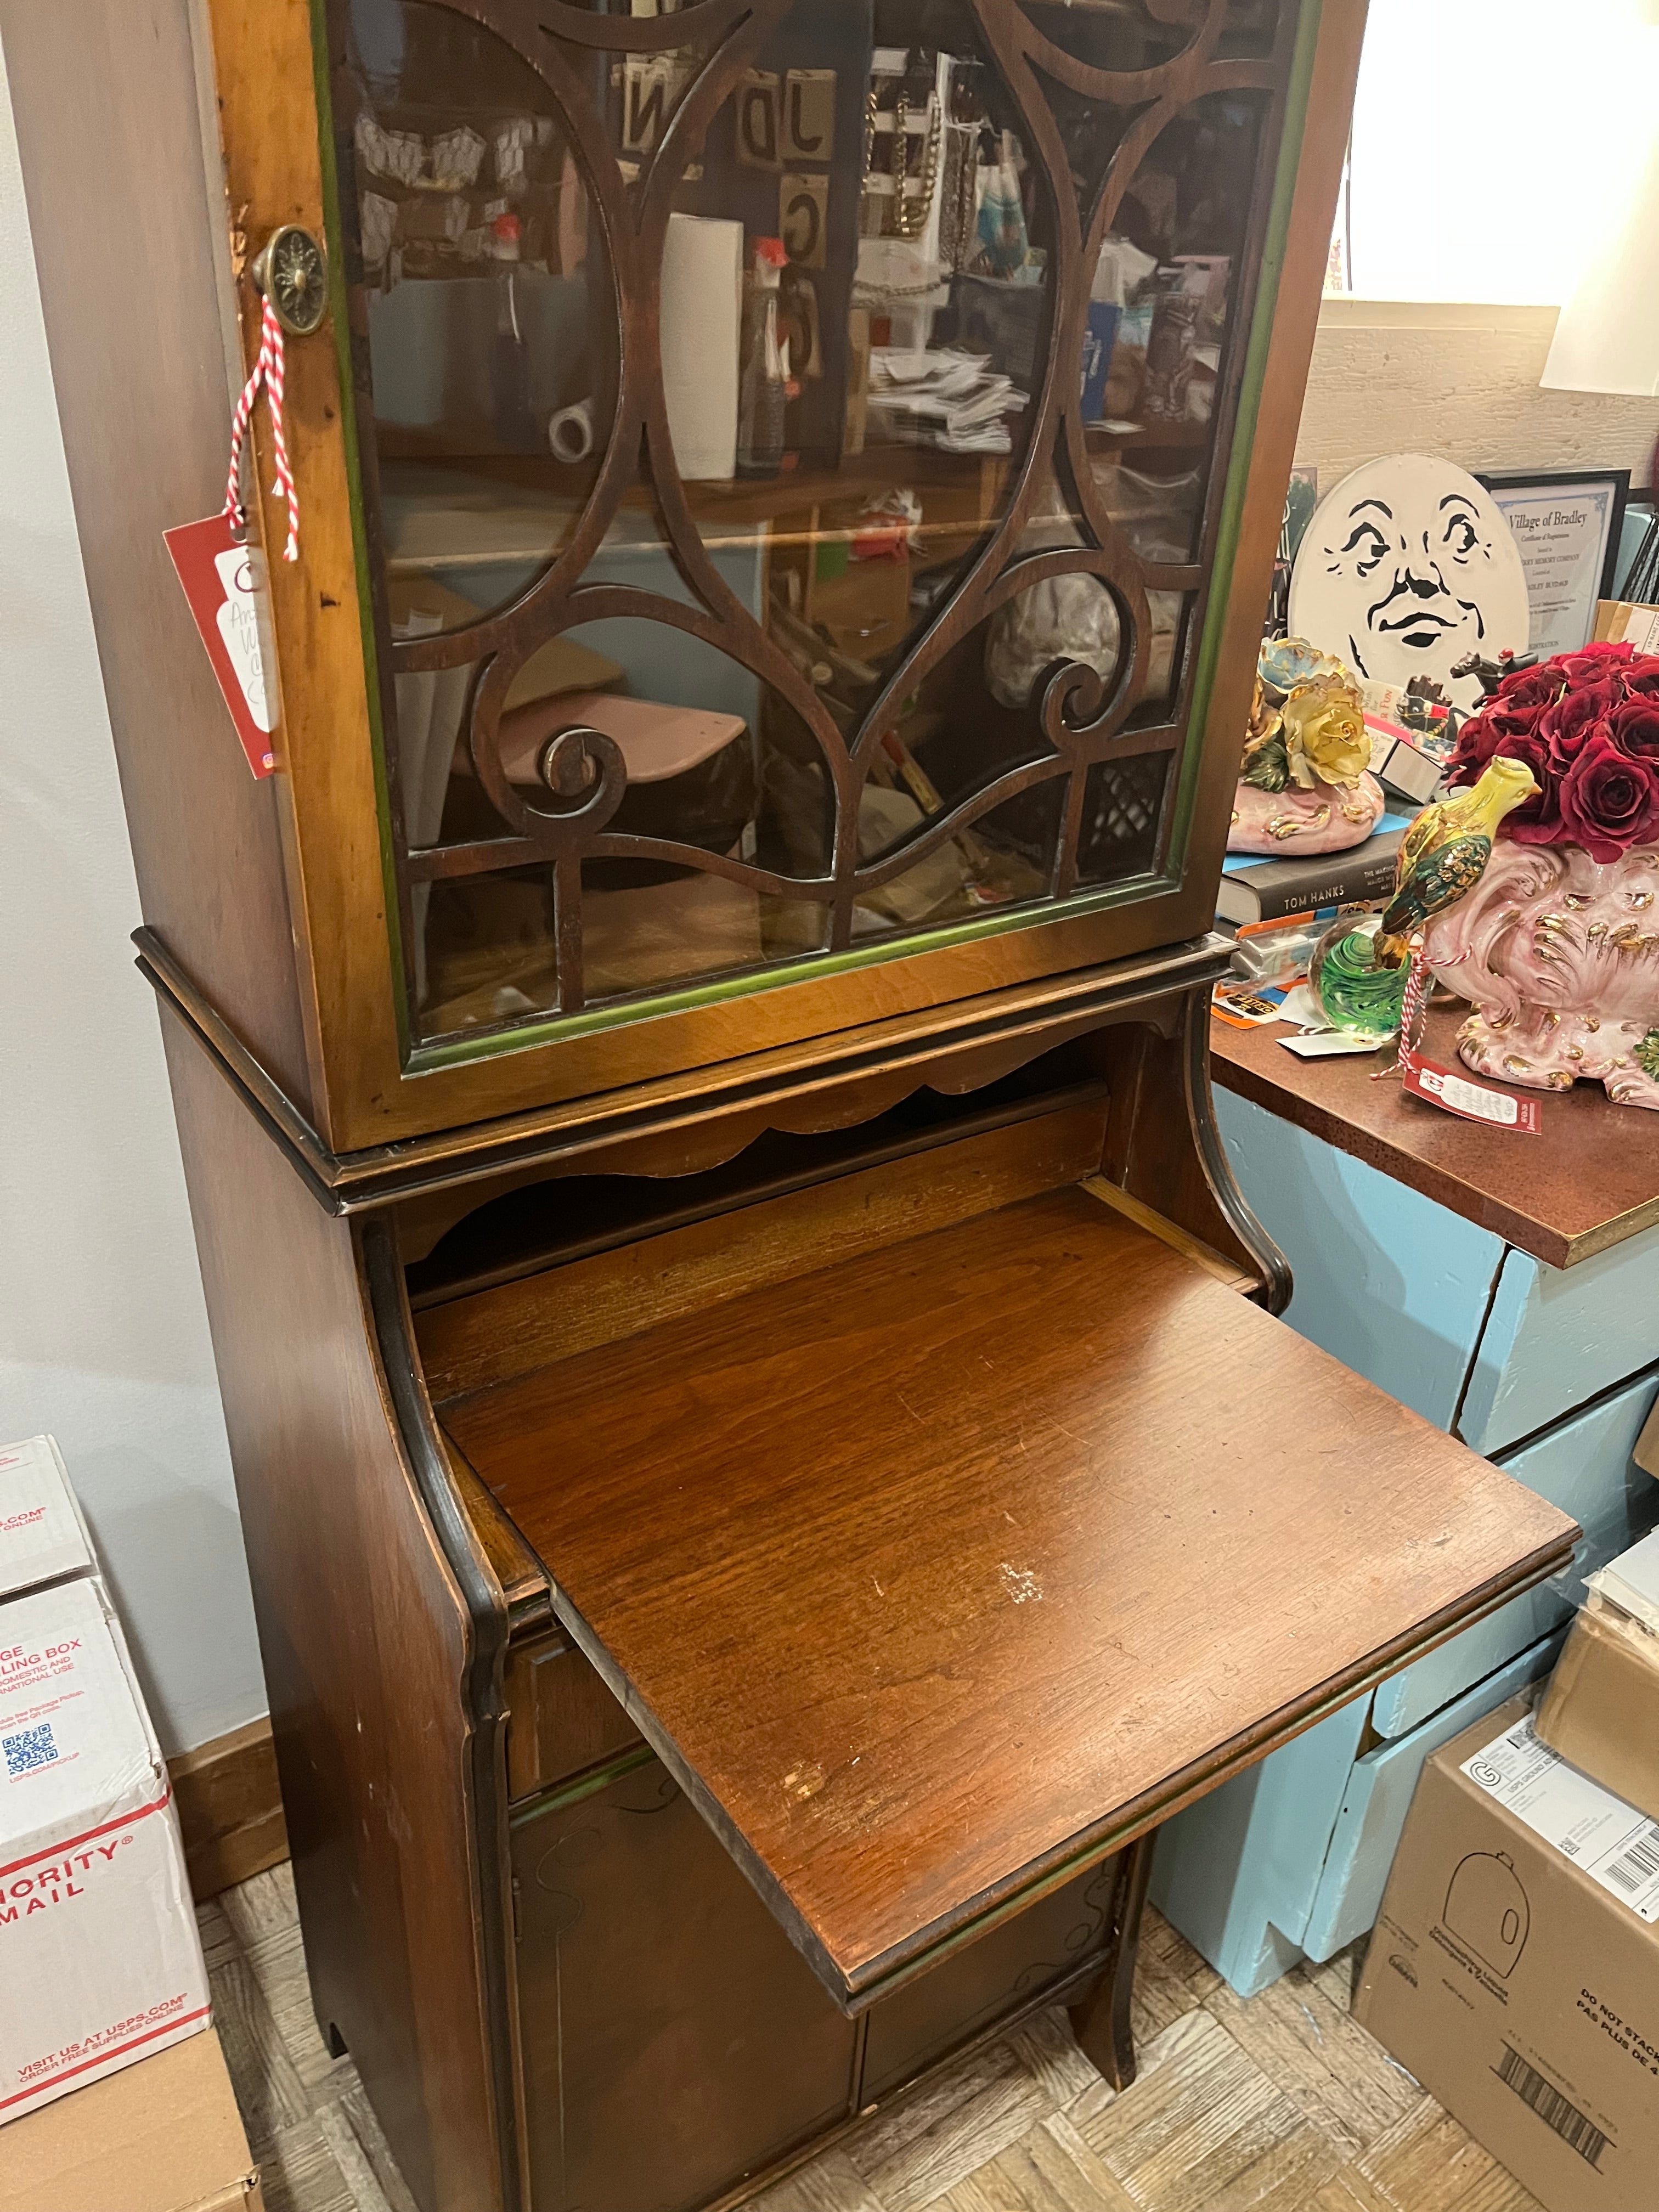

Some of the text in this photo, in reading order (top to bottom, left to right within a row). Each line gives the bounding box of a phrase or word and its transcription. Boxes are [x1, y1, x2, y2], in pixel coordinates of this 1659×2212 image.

[1510, 510, 1587, 532] Village of Bradley
[1284, 885, 1344, 910] TOM HANKS
[1235, 994, 1273, 1013] ORILLA
[3, 1515, 43, 1531] ONLINE
[0, 1646, 24, 1661] GE
[0, 1638, 82, 1675] LING BOX
[50, 1656, 70, 1668] AND
[53, 1663, 75, 1675] USE
[9, 1752, 80, 1784] USPS.COM/PICKUP
[0, 1835, 133, 1904] IORITY®
[0, 1882, 84, 1926] MAIL
[1581, 1988, 1597, 2005] DO
[1600, 2005, 1623, 2027] NOT
[20, 2003, 185, 2083] ORDER FREE SUPPLIES ONLINE
[1576, 2000, 1598, 2022] PAS
[1601, 2021, 1629, 2050] PLUS
[1632, 2049, 1649, 2067] DE
[17, 2053, 57, 2076] VISIT
[59, 2042, 81, 2057] US
[83, 2032, 103, 2047] AT
